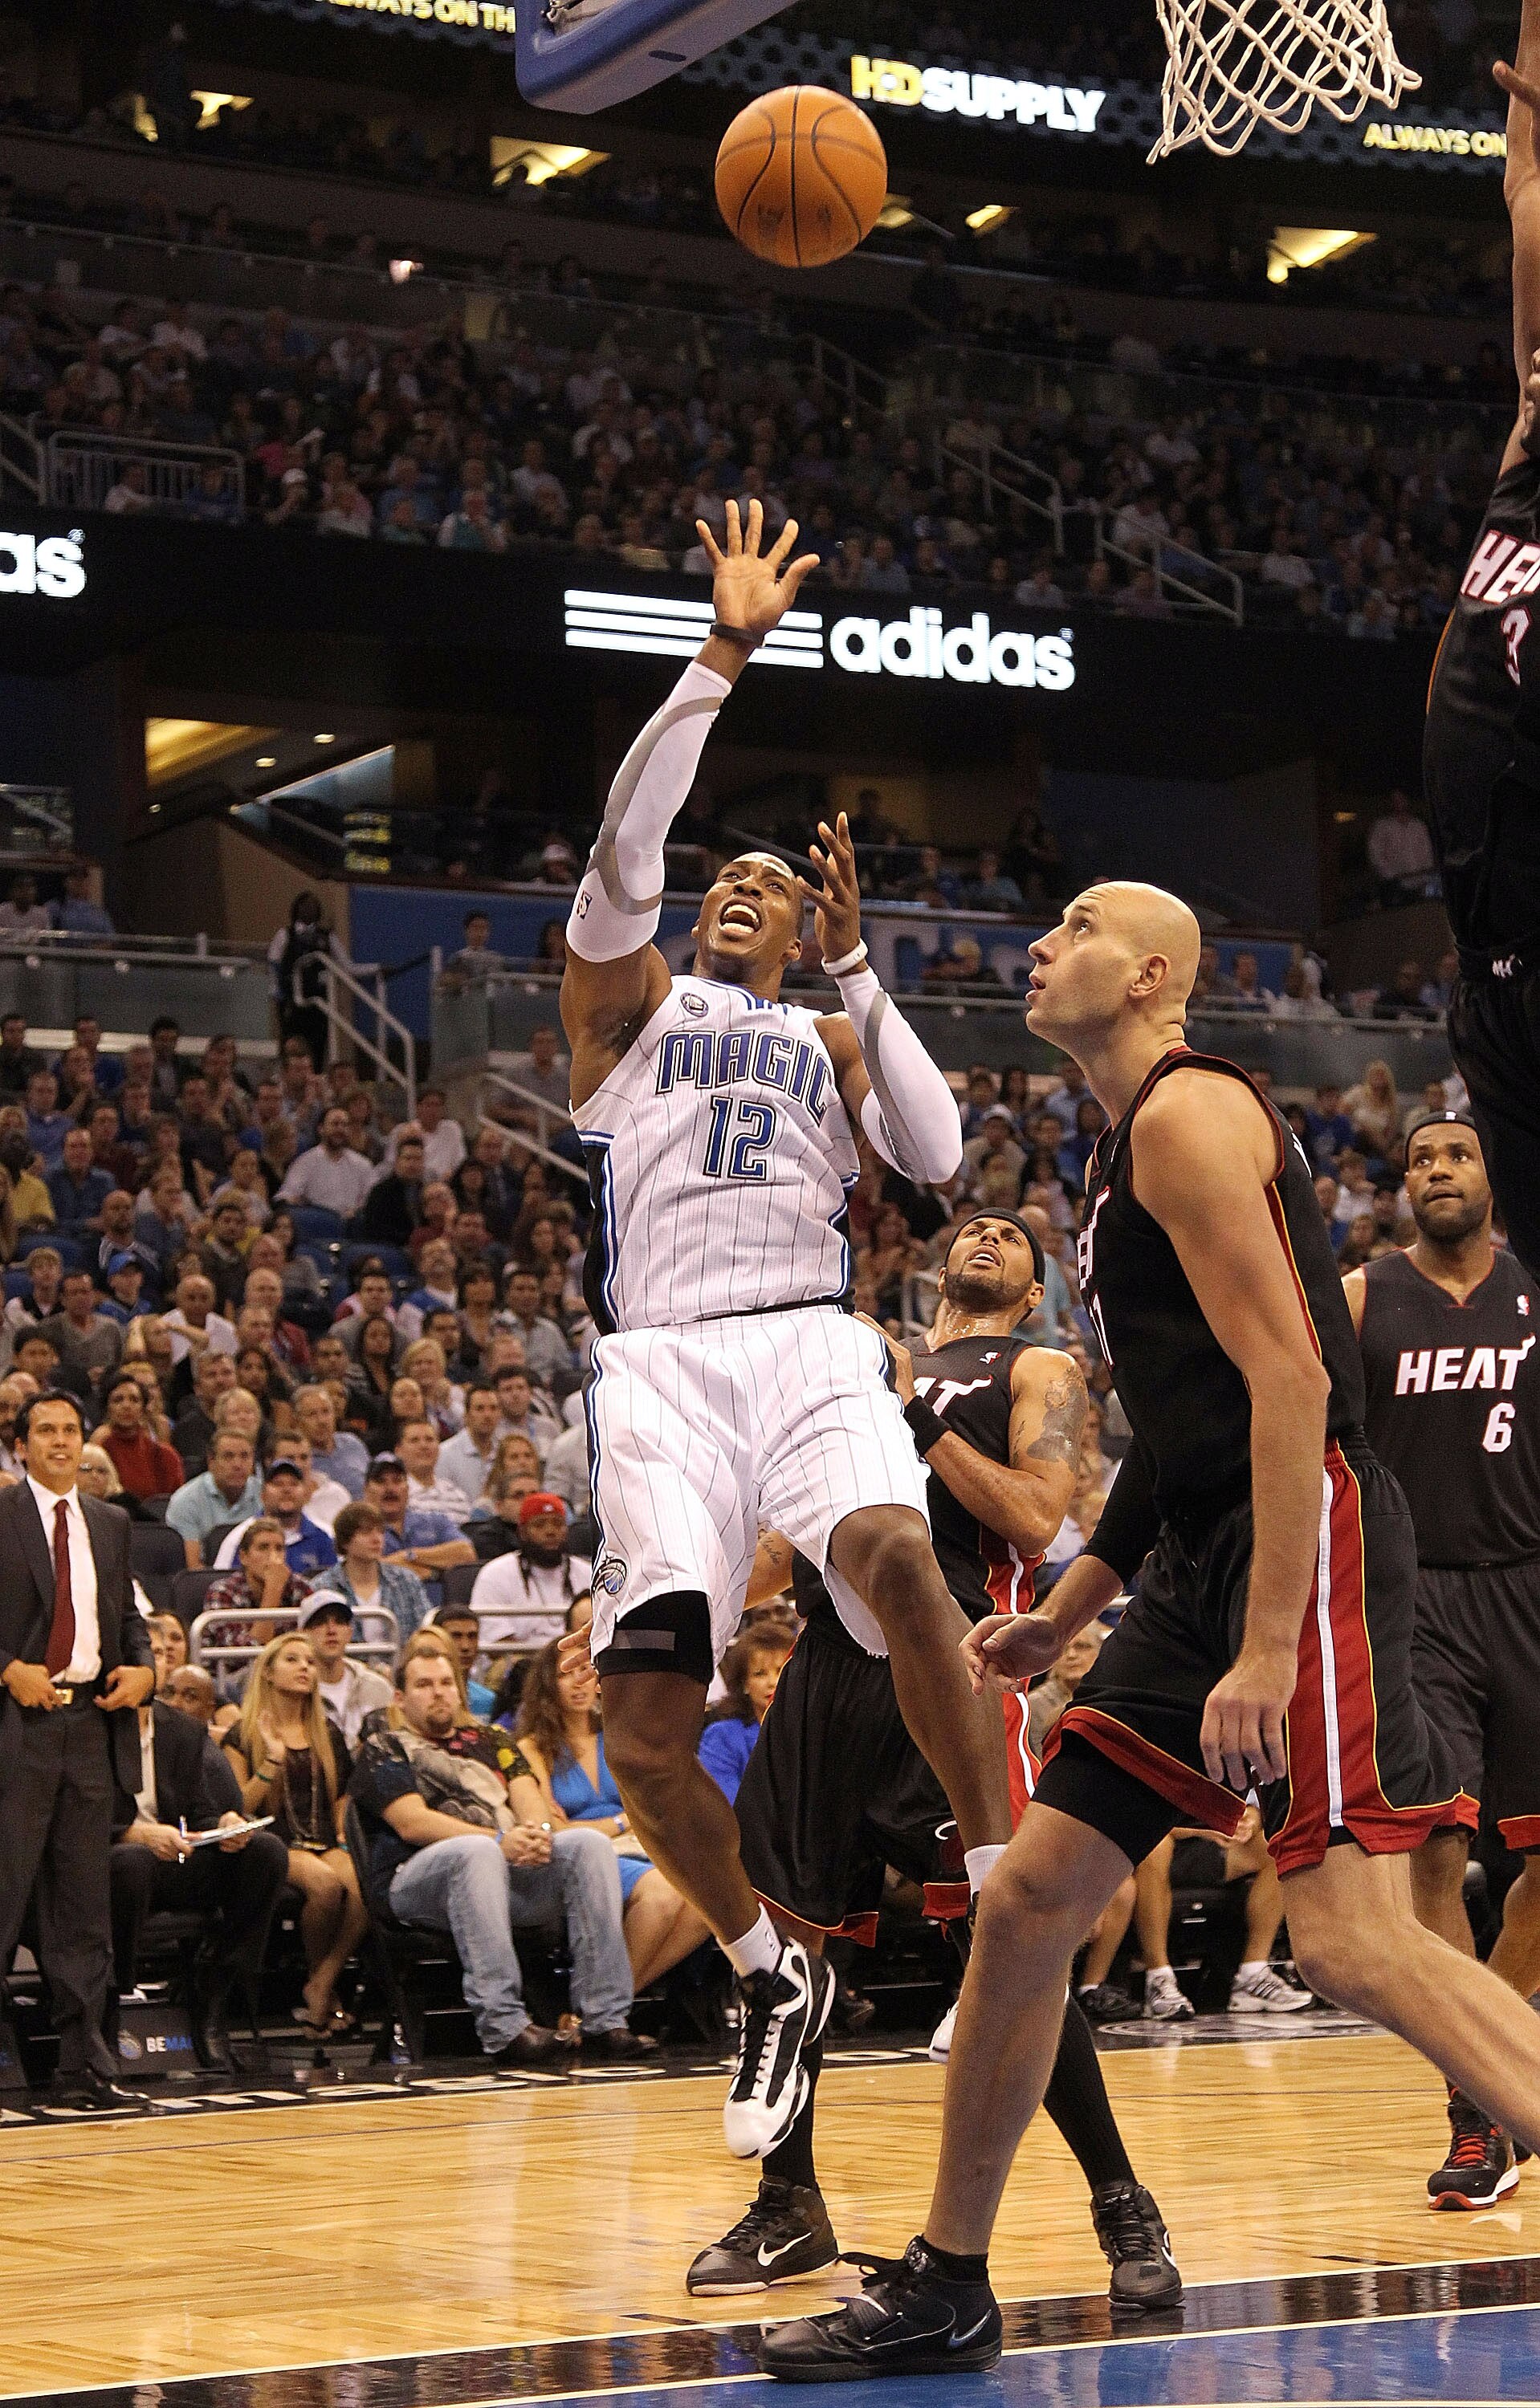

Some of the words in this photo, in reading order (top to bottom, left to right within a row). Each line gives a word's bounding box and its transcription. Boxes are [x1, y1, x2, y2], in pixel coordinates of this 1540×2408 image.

[434, 0, 479, 27] ON
[1363, 122, 1470, 156] ALWAYS
[1469, 131, 1508, 159] ON
[829, 605, 1076, 691] adidas
[655, 1030, 837, 1128] MAGIC
[703, 1095, 777, 1181] 12
[1394, 1332, 1537, 1397] HEAT
[1482, 1401, 1517, 1454] 6
